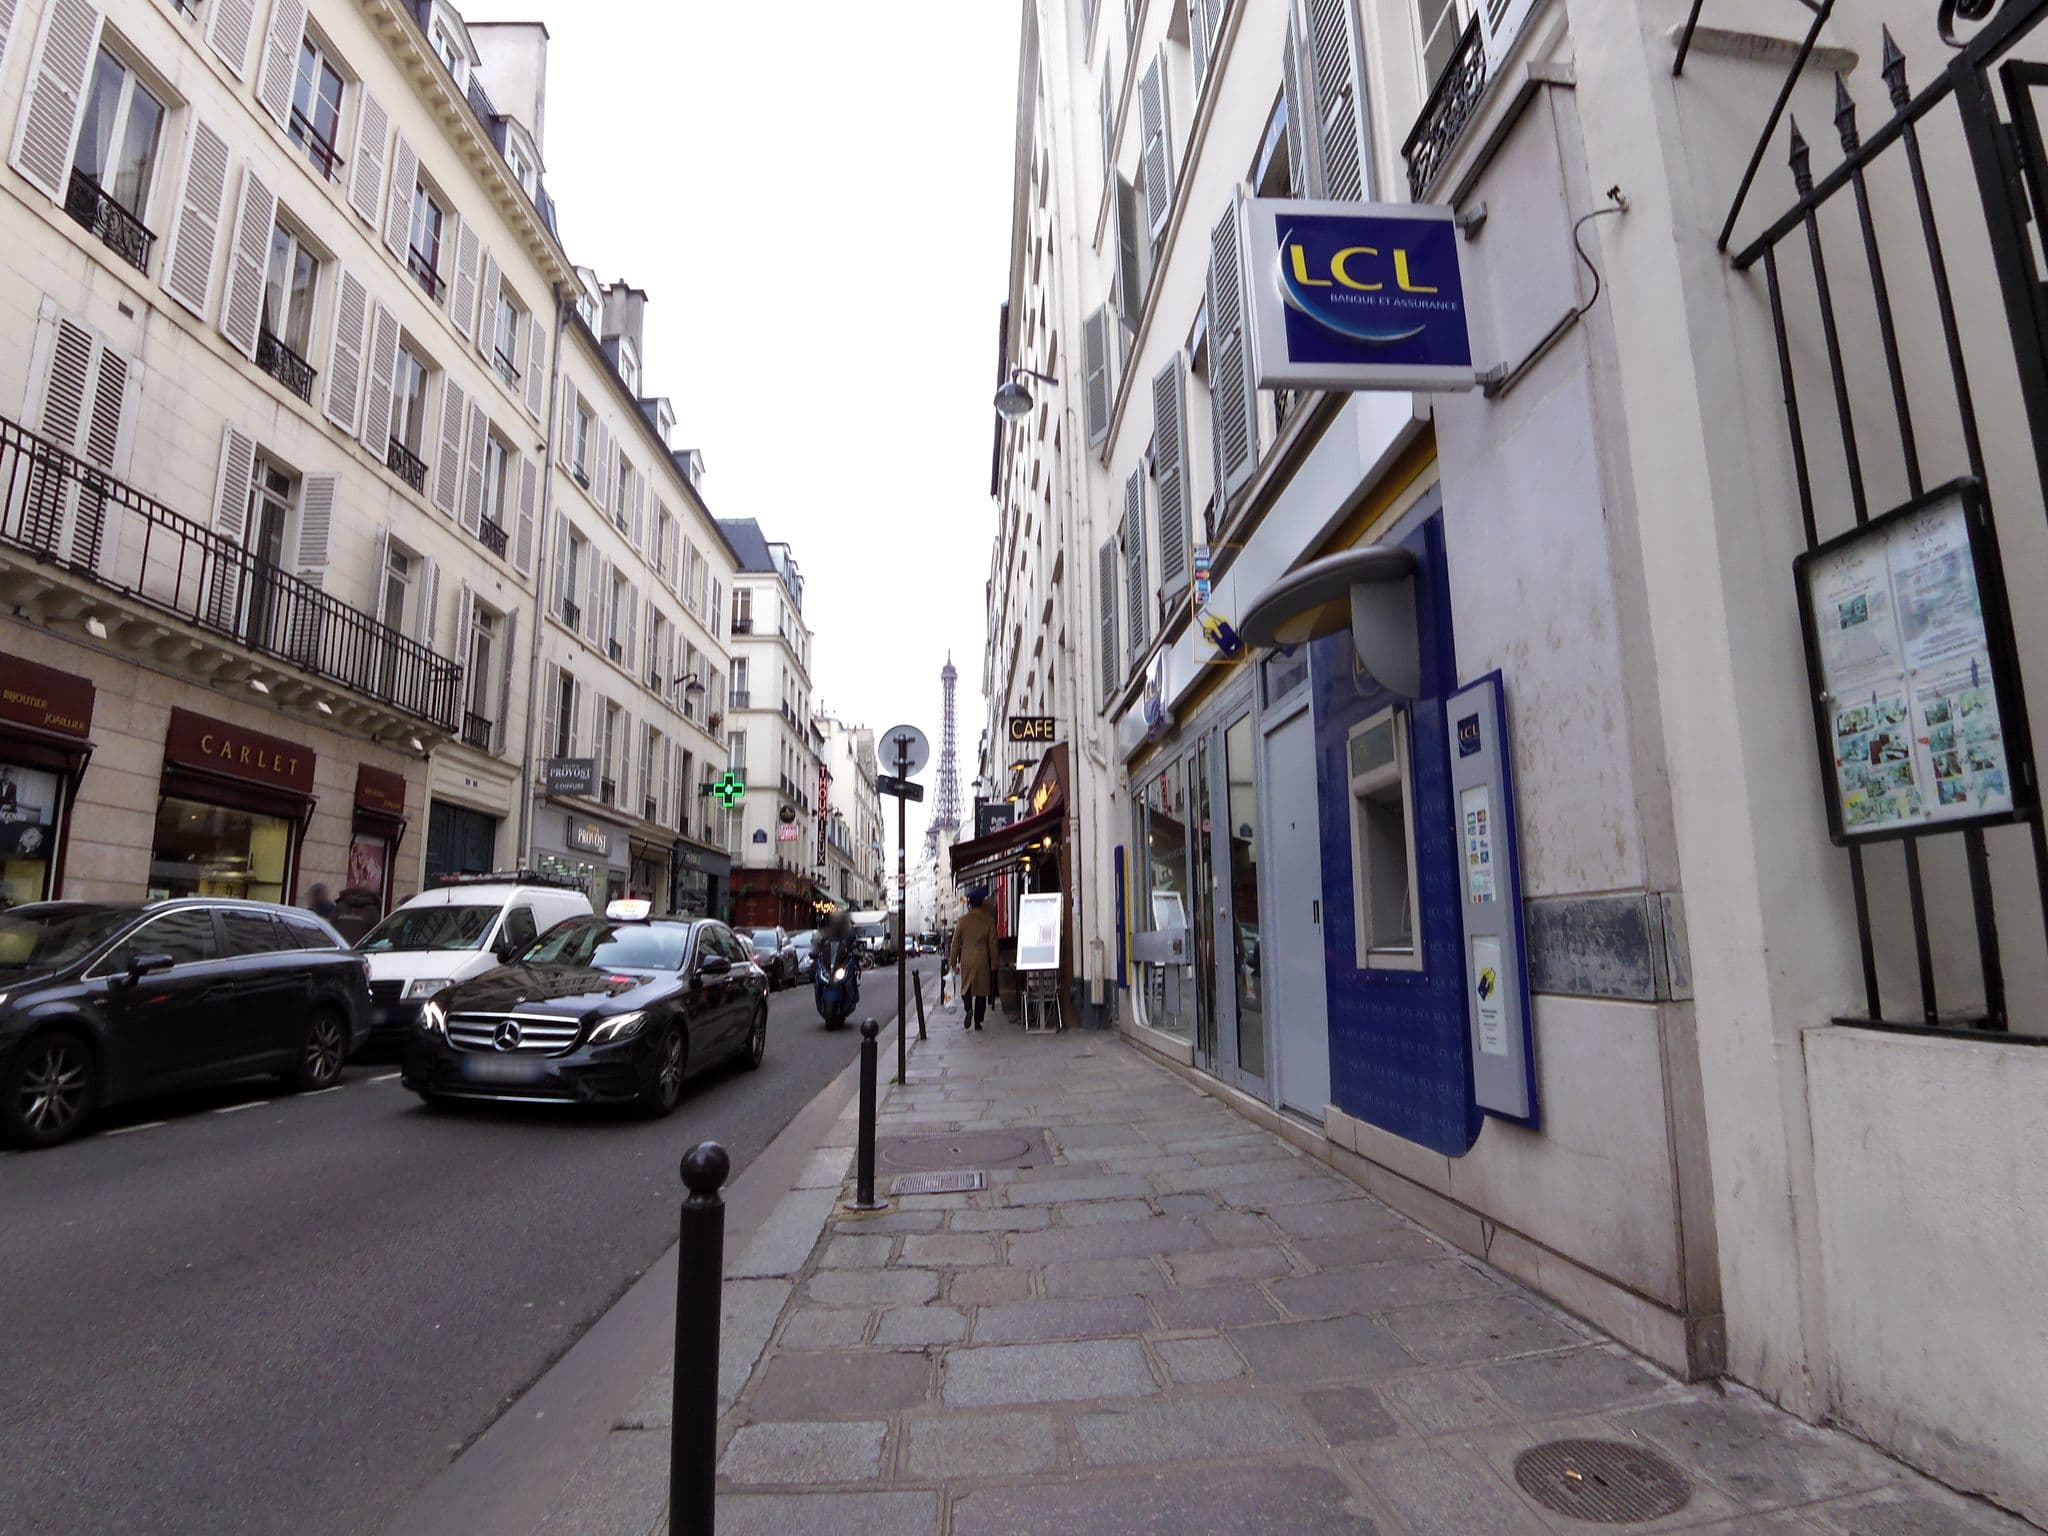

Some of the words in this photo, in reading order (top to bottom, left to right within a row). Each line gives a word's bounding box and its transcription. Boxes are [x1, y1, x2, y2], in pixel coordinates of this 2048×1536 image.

[1290, 244, 1438, 294] LCL
[1330, 292, 1376, 304] BANQUE
[1379, 296, 1392, 306] ET
[1394, 298, 1458, 312] ASSURANCE
[1011, 719, 1053, 739] CAFE
[201, 735, 298, 775] CARLET
[818, 766, 827, 864] THOUMIEUX
